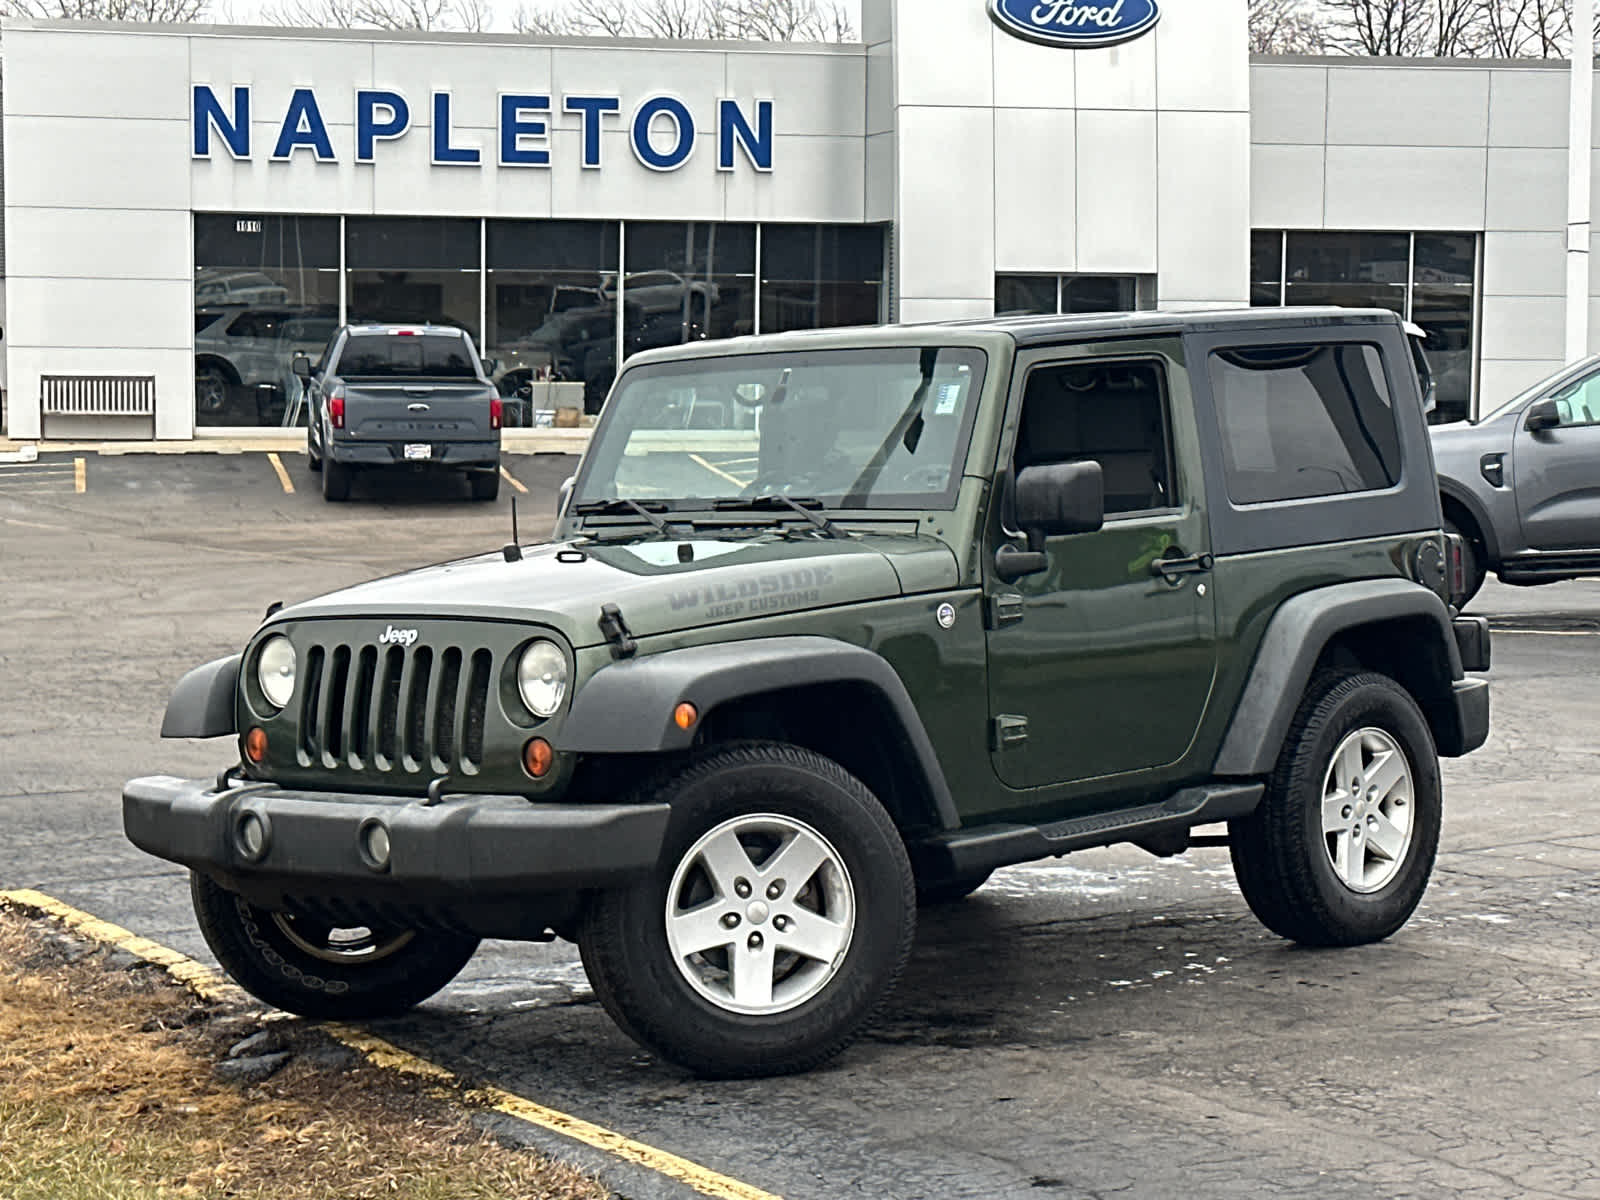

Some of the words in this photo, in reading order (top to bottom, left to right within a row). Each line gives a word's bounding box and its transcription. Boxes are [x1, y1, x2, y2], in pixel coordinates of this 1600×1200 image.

[1031, 0, 1124, 27] Ford
[191, 84, 774, 172] NAPLETON
[667, 565, 833, 611] WILDSIDE
[706, 601, 745, 618] JEEP
[749, 589, 820, 611] CUSTOMS
[379, 624, 418, 647] Jeep
